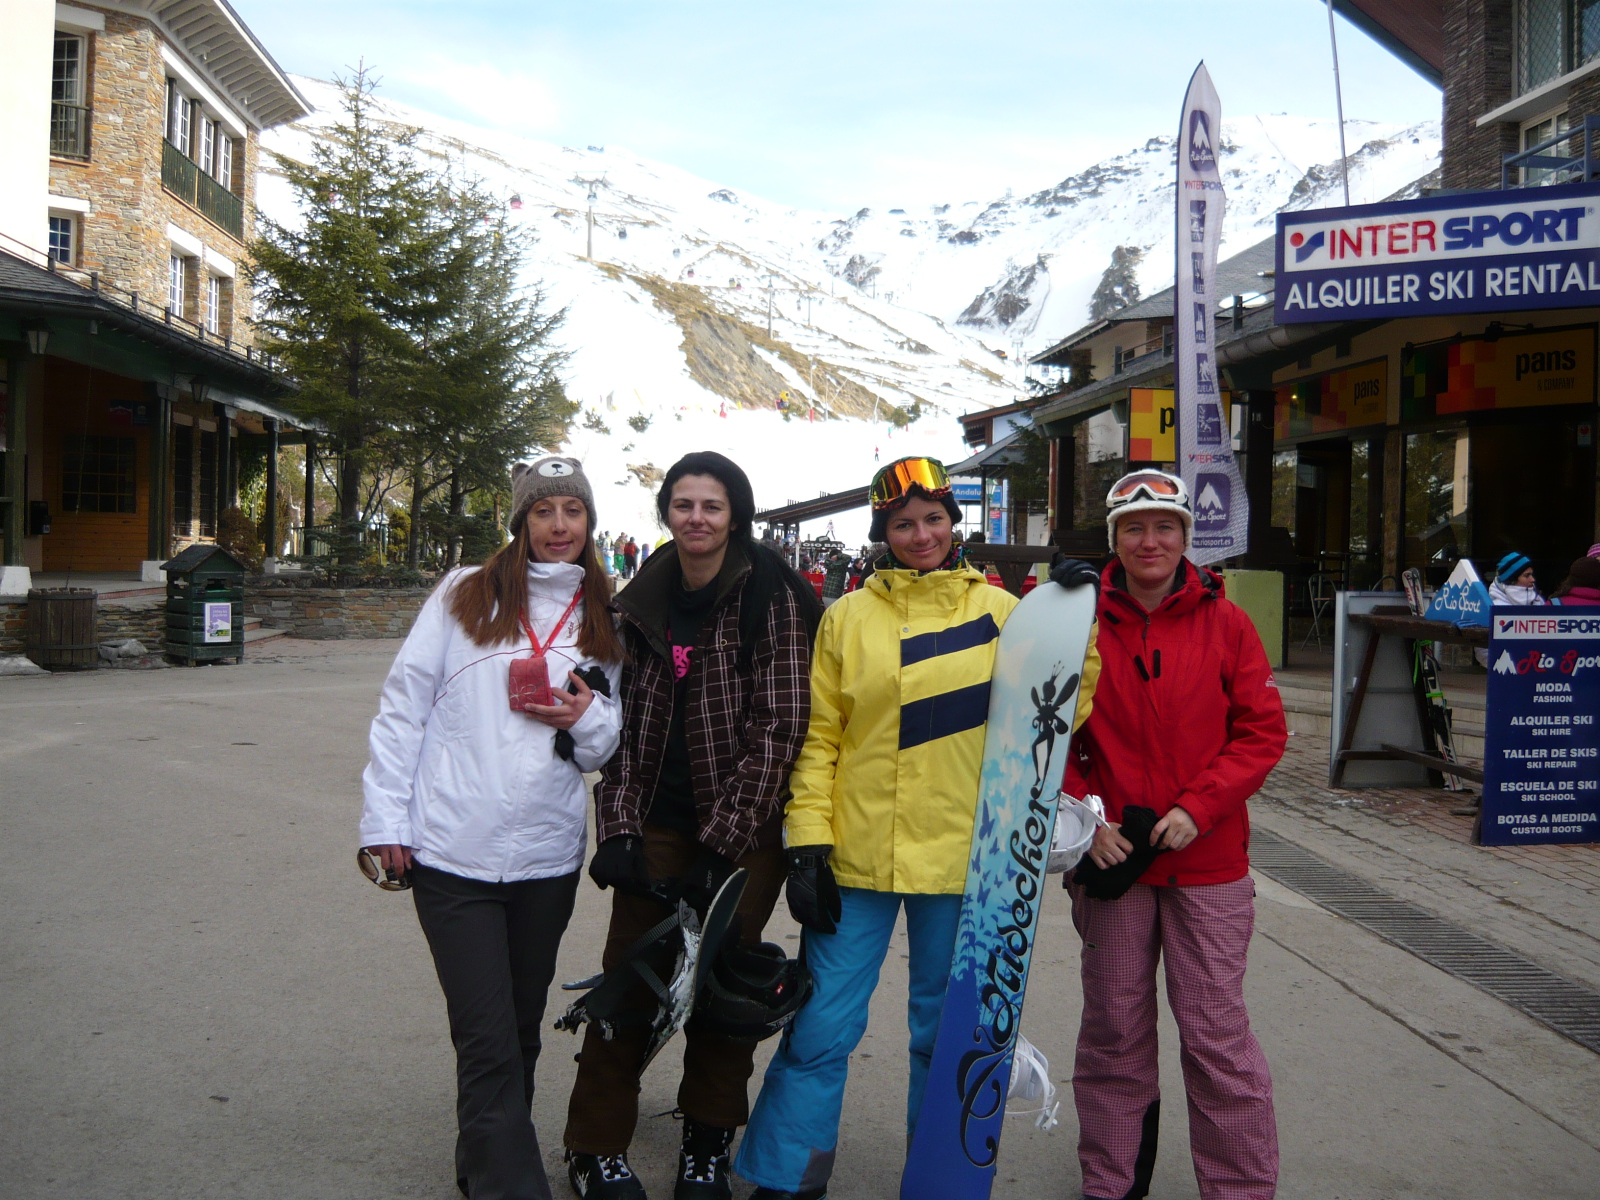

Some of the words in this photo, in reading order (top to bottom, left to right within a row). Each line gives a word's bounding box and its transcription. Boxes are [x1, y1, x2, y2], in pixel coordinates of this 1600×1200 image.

[1284, 274, 1420, 311] ALQUILER
[1429, 270, 1473, 301] SKI
[1485, 262, 1600, 297] RENTAL
[1515, 349, 1576, 381] pans
[1543, 377, 1575, 391] COMPANY
[1354, 378, 1380, 406] pans
[1434, 587, 1457, 611] Rio
[1458, 585, 1481, 620] Sport
[1514, 619, 1600, 634] INTERSPOR
[1516, 650, 1555, 675] Rio
[1535, 683, 1571, 692] MODA
[1533, 695, 1572, 703] FASHION
[1510, 716, 1570, 726] ALQUILER
[1573, 715, 1593, 725] SKI
[1532, 728, 1547, 736] SKI
[1503, 749, 1547, 759] TALLER
[1551, 748, 1568, 758] DE
[1570, 748, 1597, 757] SKIS
[1526, 761, 1542, 769] SKI
[1500, 781, 1555, 791] ESCUELA
[1558, 781, 1574, 790] DE
[1577, 780, 1597, 790] SKI
[1521, 794, 1537, 802] SKI
[1539, 793, 1576, 801] SCHOOL
[1497, 814, 1537, 824] BOTAS
[1540, 814, 1548, 824] A
[1551, 812, 1597, 823] MEDIDA
[1511, 826, 1550, 834] CUSTOM
[1552, 825, 1582, 833] BOOTS
